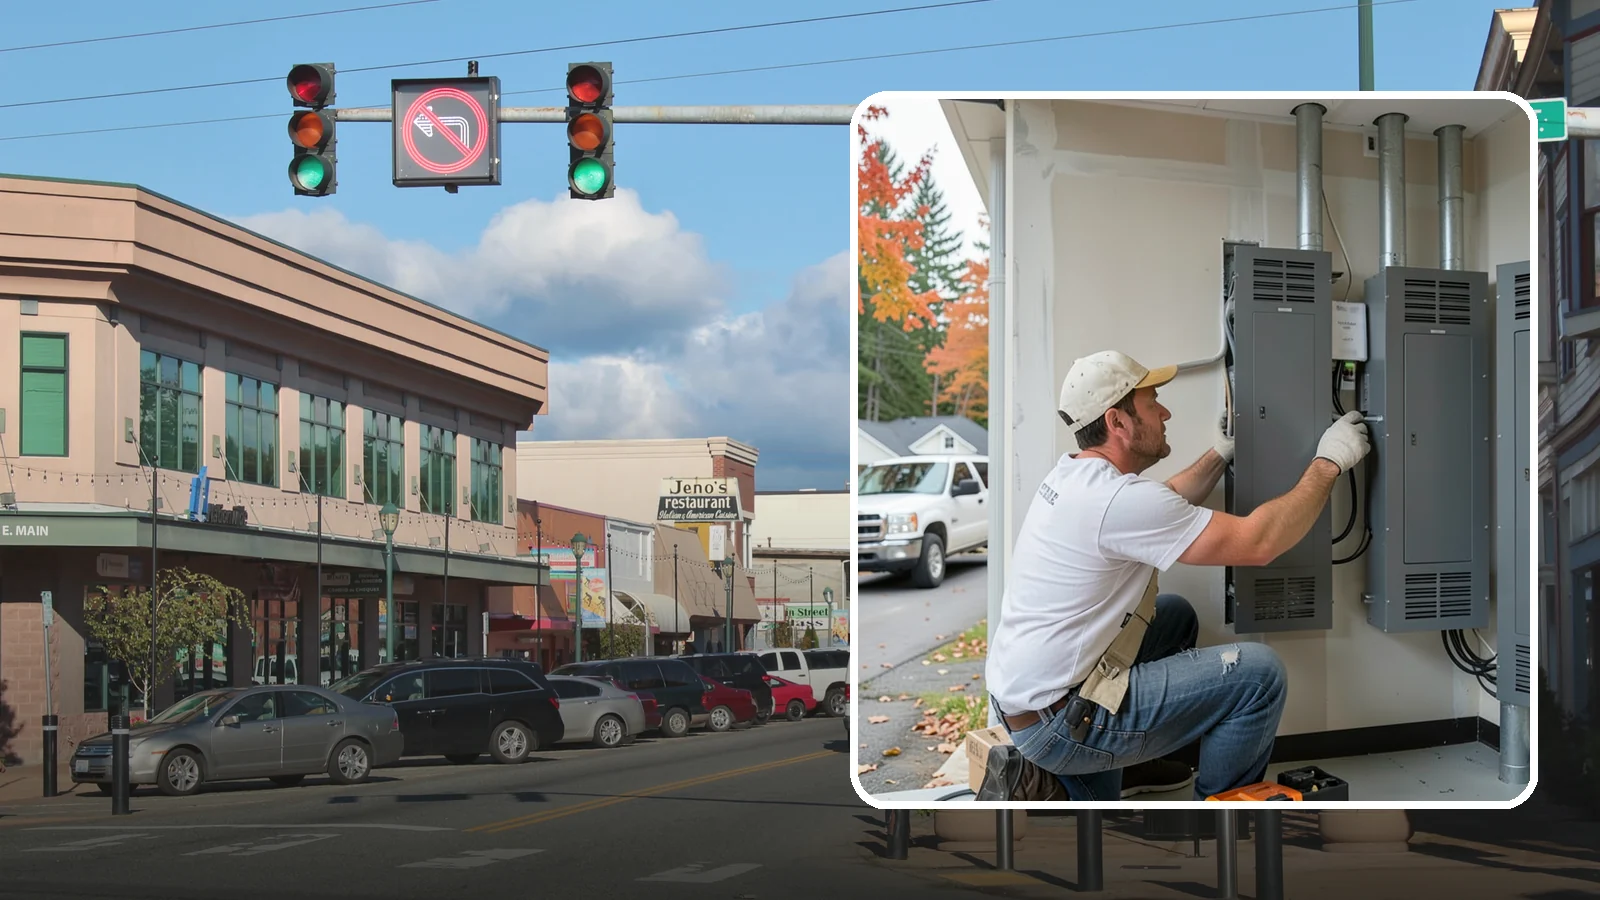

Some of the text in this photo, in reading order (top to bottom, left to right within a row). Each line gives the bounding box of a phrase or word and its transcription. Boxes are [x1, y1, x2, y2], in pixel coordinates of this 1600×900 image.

[670, 480, 727, 494] Jeno's
[665, 496, 731, 509] restaurant
[659, 509, 681, 519] Italian
[686, 509, 714, 519] American
[715, 509, 738, 519] Cuisine
[2, 525, 49, 536] E. MAIN
[797, 608, 828, 616] Street
